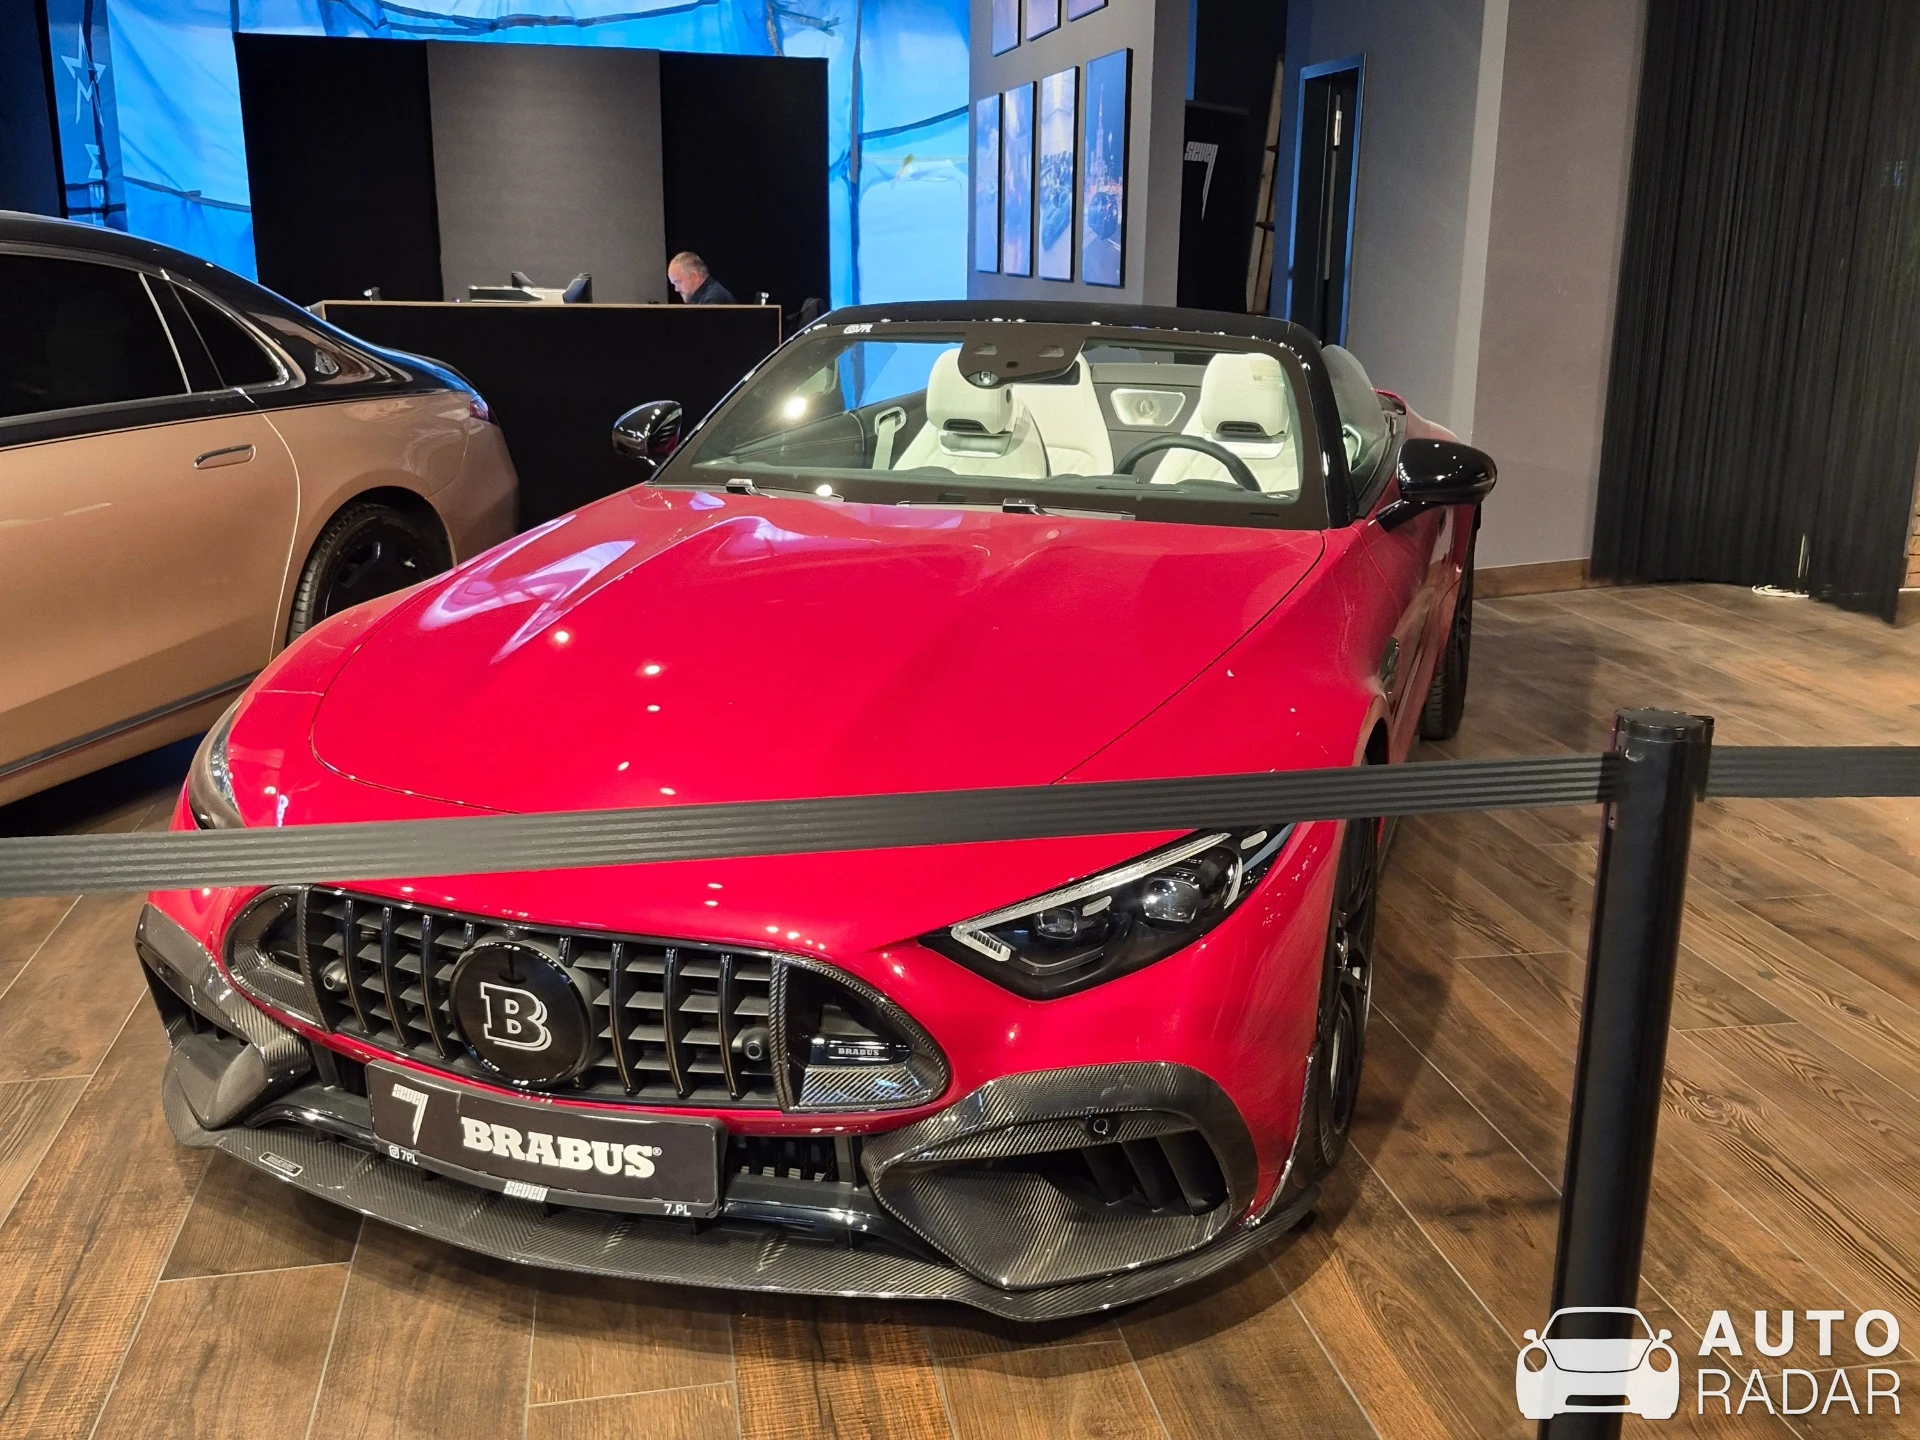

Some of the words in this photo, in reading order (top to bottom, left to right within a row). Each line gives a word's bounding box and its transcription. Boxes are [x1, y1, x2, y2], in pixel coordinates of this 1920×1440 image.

[838, 1047, 880, 1056] BRABUS
[400, 1149, 419, 1166] 7PL
[664, 1203, 691, 1215] 7.PL
